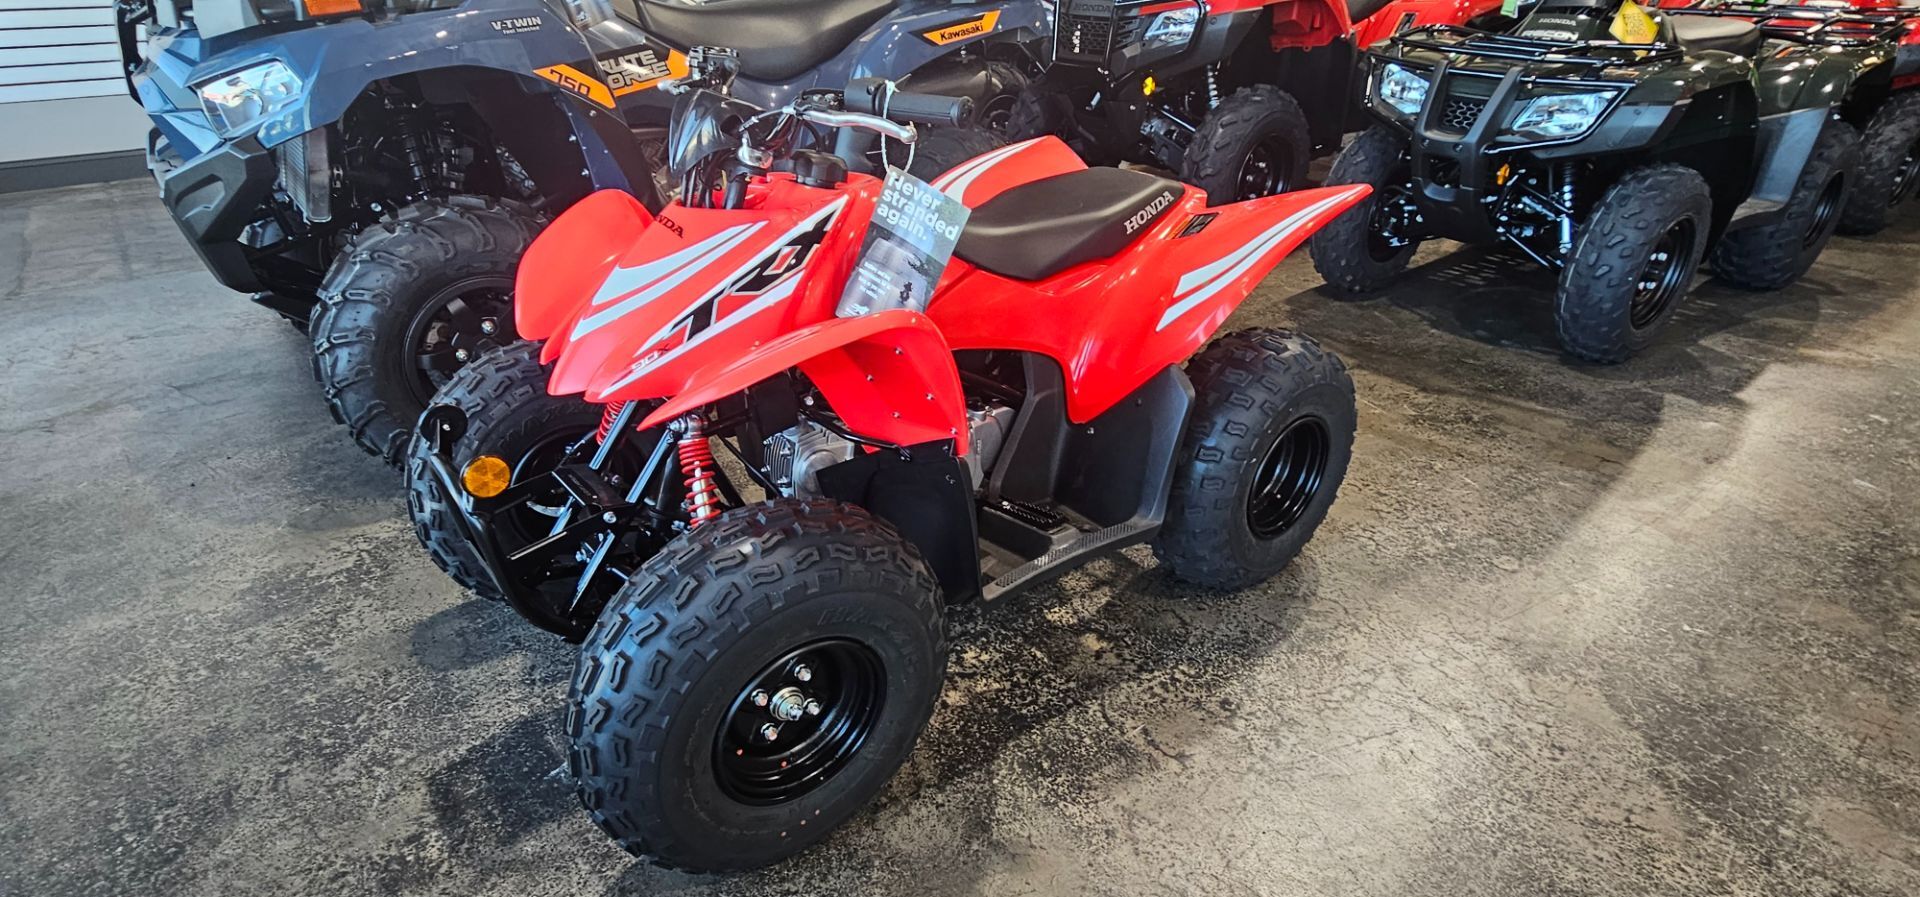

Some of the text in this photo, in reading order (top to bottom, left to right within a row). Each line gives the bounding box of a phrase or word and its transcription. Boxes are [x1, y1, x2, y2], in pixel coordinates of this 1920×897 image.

[490, 16, 541, 30] V-TWIN
[939, 22, 984, 42] Kawasaki
[1538, 17, 1577, 27] HONDA
[887, 171, 942, 211] Never
[876, 203, 928, 241] again.
[881, 188, 960, 241] stranded
[1123, 190, 1175, 235] HONDA
[664, 196, 848, 344] TRX
